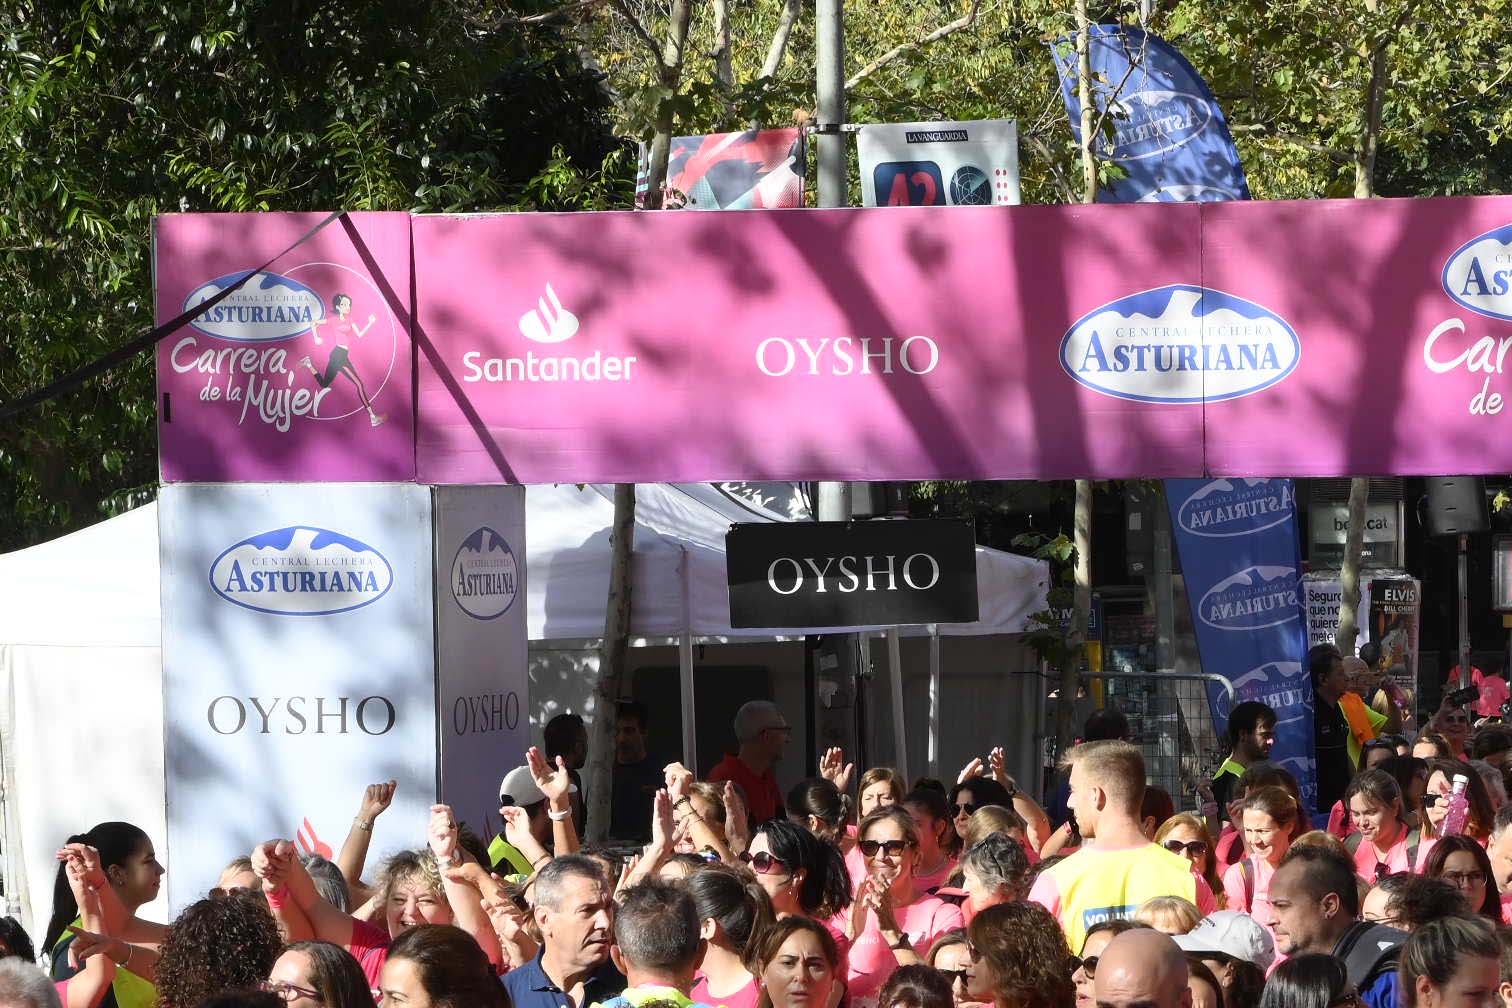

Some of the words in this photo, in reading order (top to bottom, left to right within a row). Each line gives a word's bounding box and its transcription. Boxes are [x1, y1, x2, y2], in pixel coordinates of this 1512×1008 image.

[907, 133, 916, 142] LA
[916, 130, 968, 142] VANGUARDIA
[194, 296, 313, 323] ASTURIANA
[1115, 326, 1193, 338] CENTRAL
[1199, 325, 1274, 337] LECHERA
[170, 336, 288, 374] Carrera
[462, 350, 637, 382] Santander
[755, 334, 940, 377] OYSHO
[1079, 331, 1281, 373] ASTURIANA
[200, 376, 221, 401] de
[226, 375, 242, 401] la
[238, 370, 332, 433] Mujer
[1468, 377, 1504, 415] de
[224, 559, 380, 593] ASTURIANA
[252, 557, 308, 567] CENTRAL
[312, 557, 375, 566] LECHERA
[766, 553, 940, 595] OYSHO
[456, 564, 515, 597] ASTURIANA
[1384, 589, 1415, 601] ELVIS
[207, 695, 397, 735] OYSHO
[453, 692, 520, 736] OYSHO
